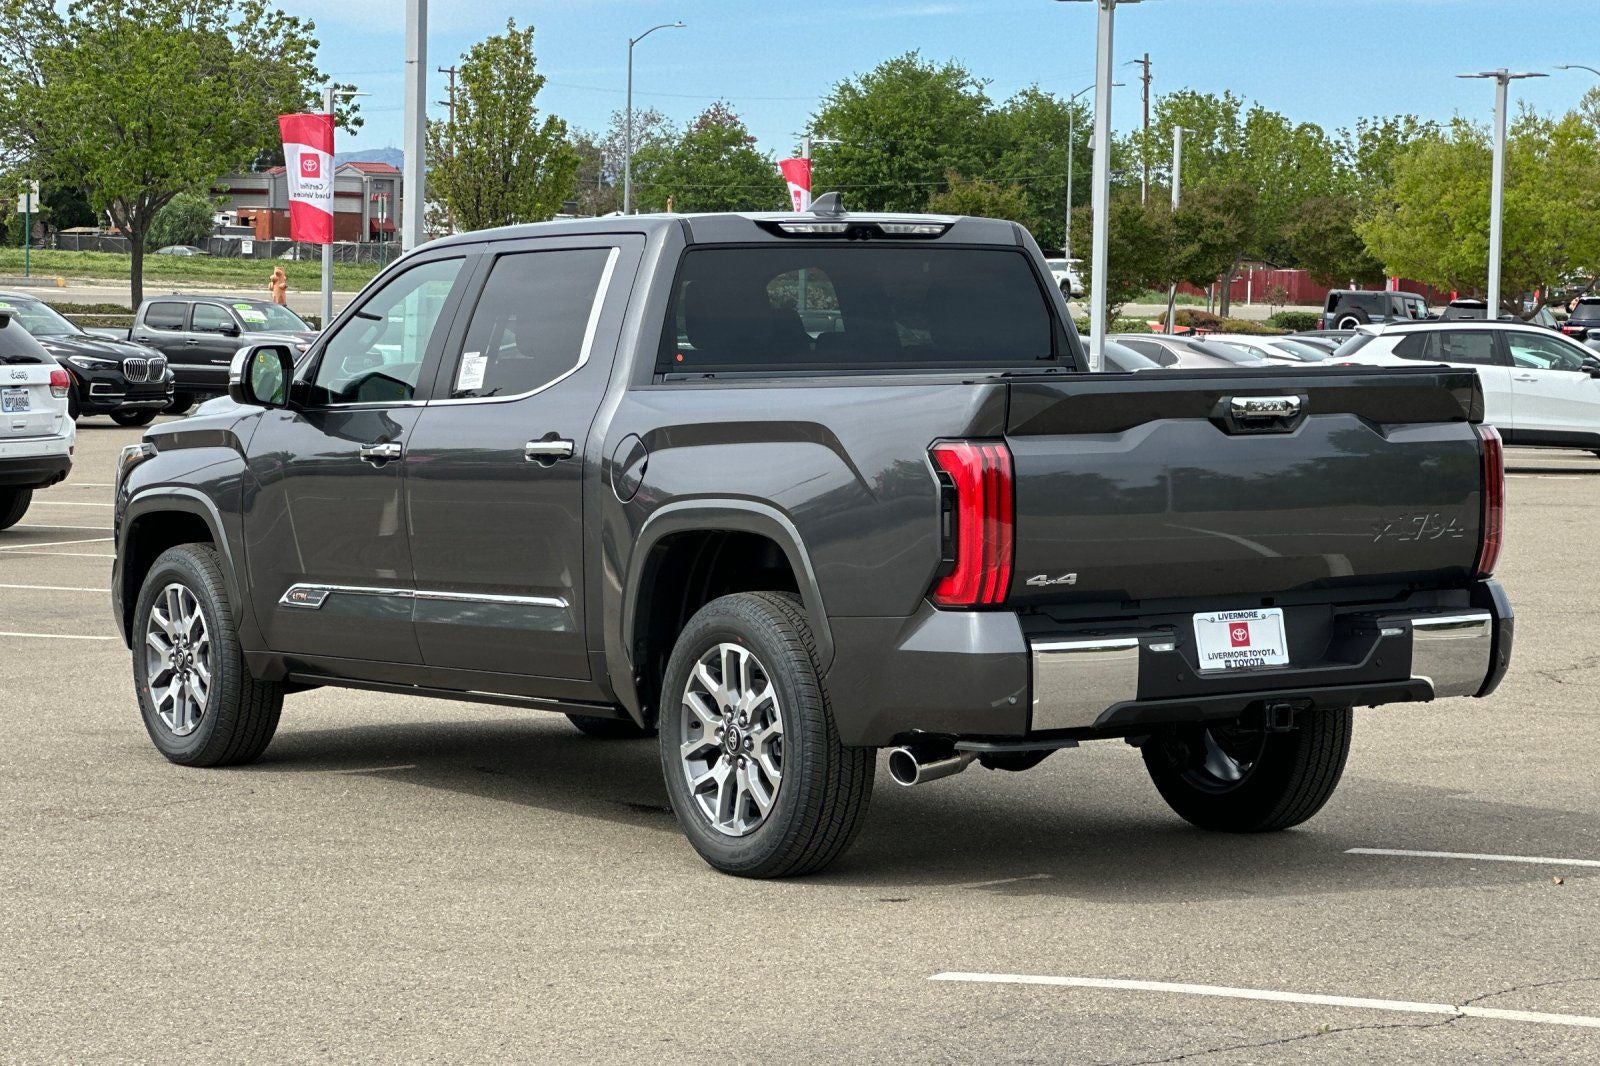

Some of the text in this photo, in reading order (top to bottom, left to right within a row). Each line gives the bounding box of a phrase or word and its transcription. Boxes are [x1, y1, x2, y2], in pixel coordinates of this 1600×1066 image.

[11, 370, 28, 380] Jeep
[1026, 573, 1077, 586] 4x4
[1218, 611, 1258, 620] LIVERMORE
[1208, 649, 1276, 660] LIVERMORE TOYOTA
[1233, 658, 1265, 667] TOYOTA
